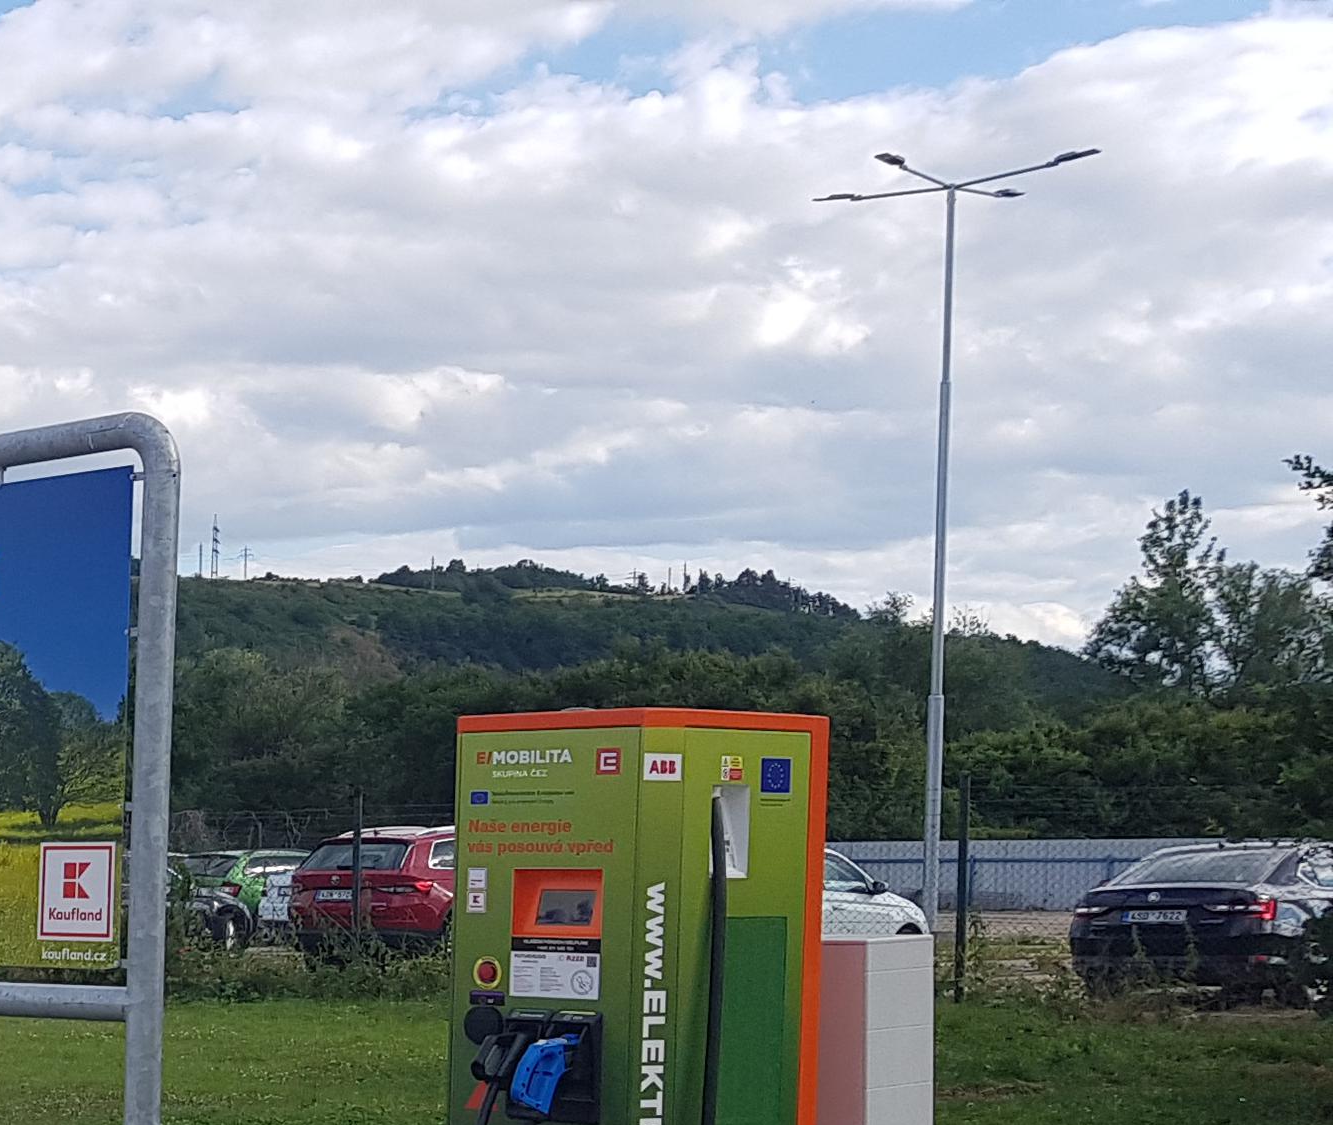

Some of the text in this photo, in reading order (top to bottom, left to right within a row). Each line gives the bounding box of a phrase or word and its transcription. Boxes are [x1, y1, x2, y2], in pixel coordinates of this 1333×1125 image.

[649, 760, 677, 774] ABB
[468, 818, 572, 835] Naše energie
[468, 840, 493, 853] vás
[48, 907, 103, 921] Kaufland
[41, 947, 107, 961] kaufland.cz
